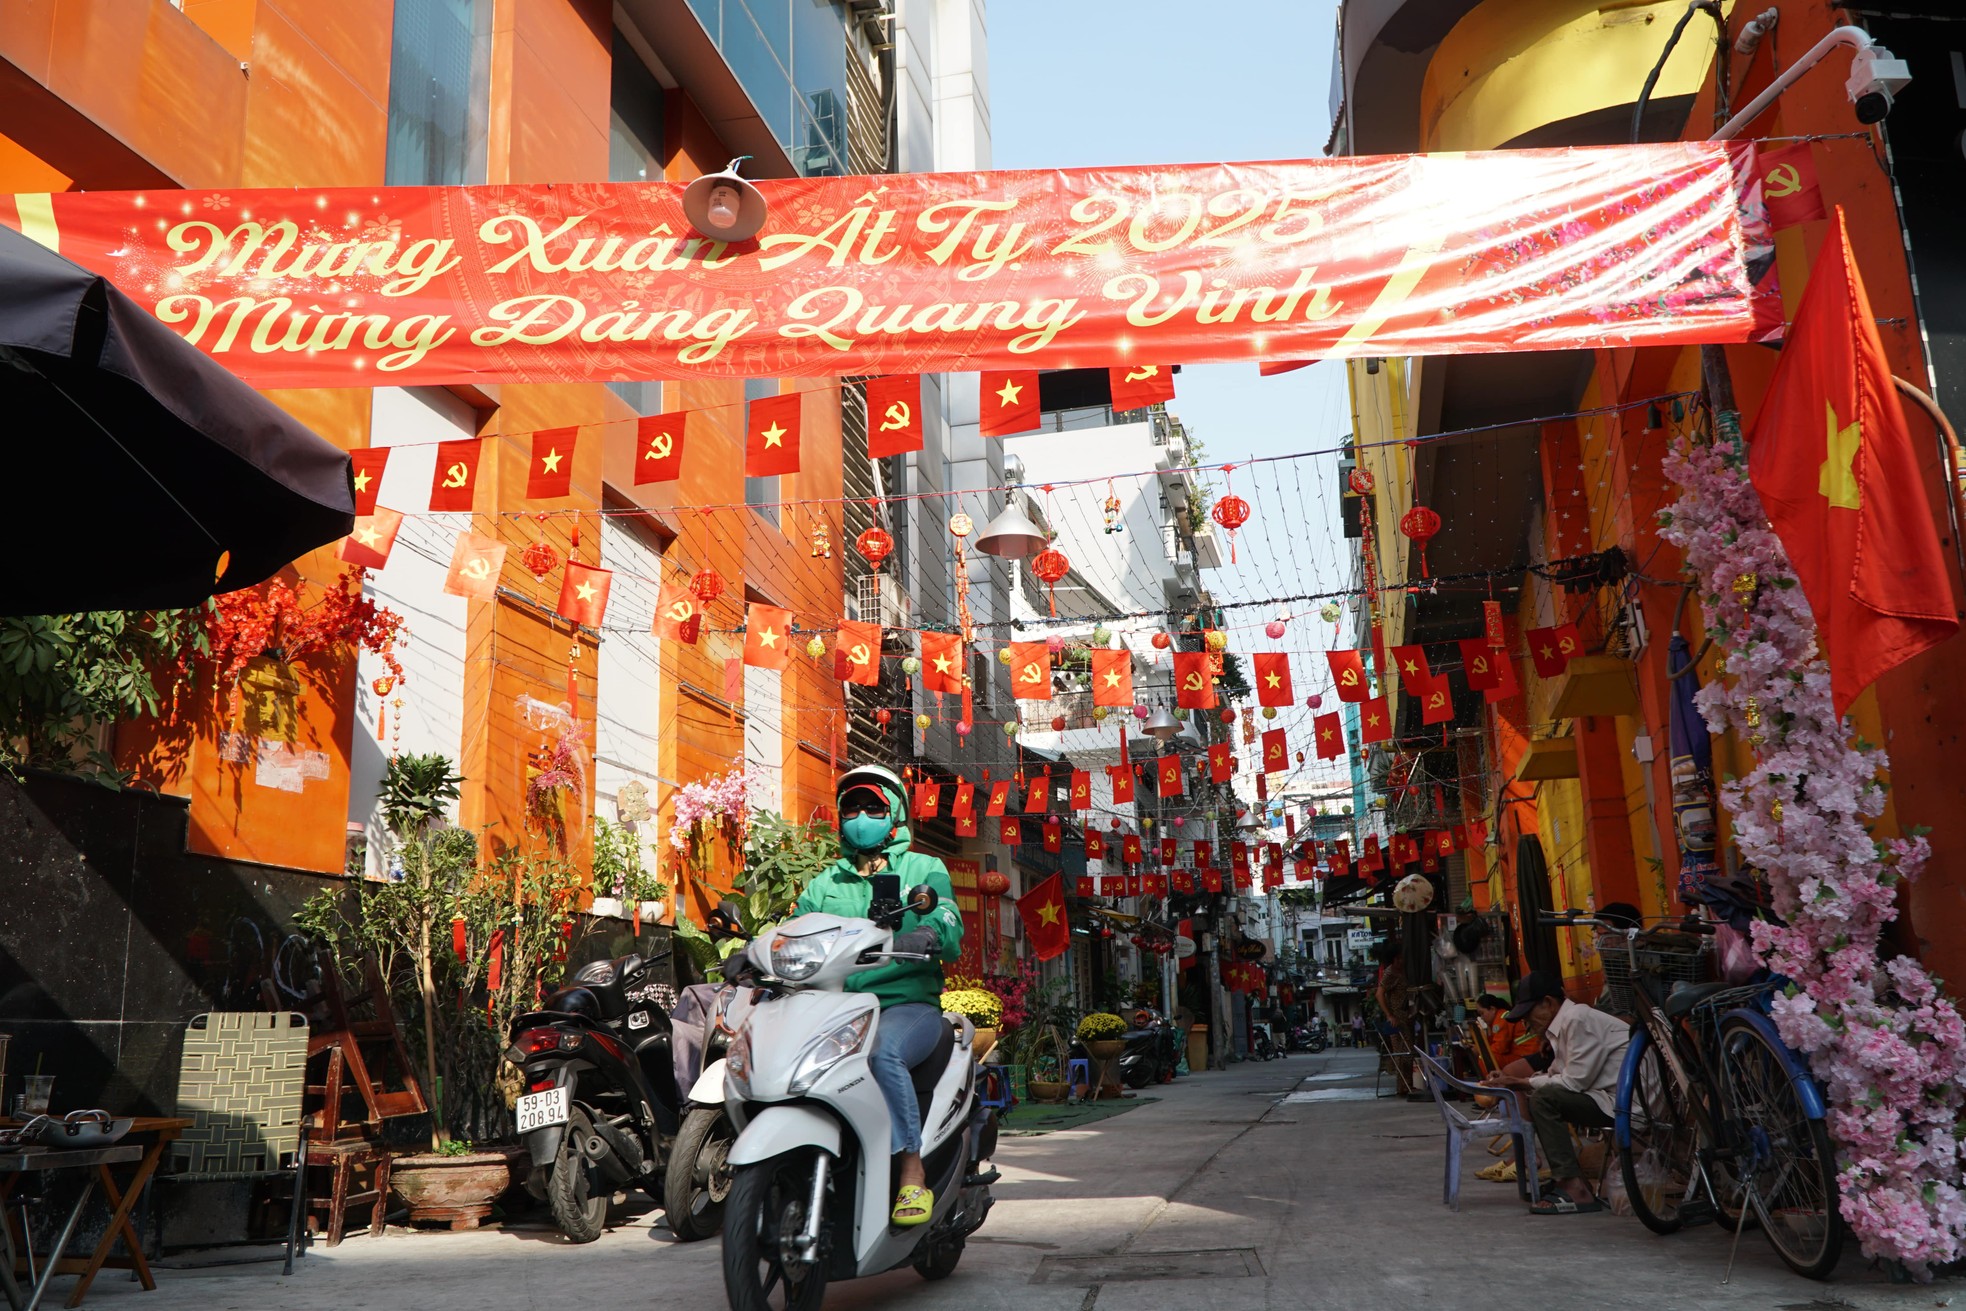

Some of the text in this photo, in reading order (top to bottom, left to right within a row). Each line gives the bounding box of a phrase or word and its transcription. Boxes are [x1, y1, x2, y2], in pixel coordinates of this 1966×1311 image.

[166, 220, 462, 297] Mừng
[479, 215, 740, 274] Xuân
[757, 186, 902, 272] Ất
[1050, 188, 1348, 255] 2025
[155, 266, 1344, 371] Mừng Đảng Quang Vinh
[520, 1105, 564, 1130] 208.94
[523, 1090, 560, 1112] 59-D3
